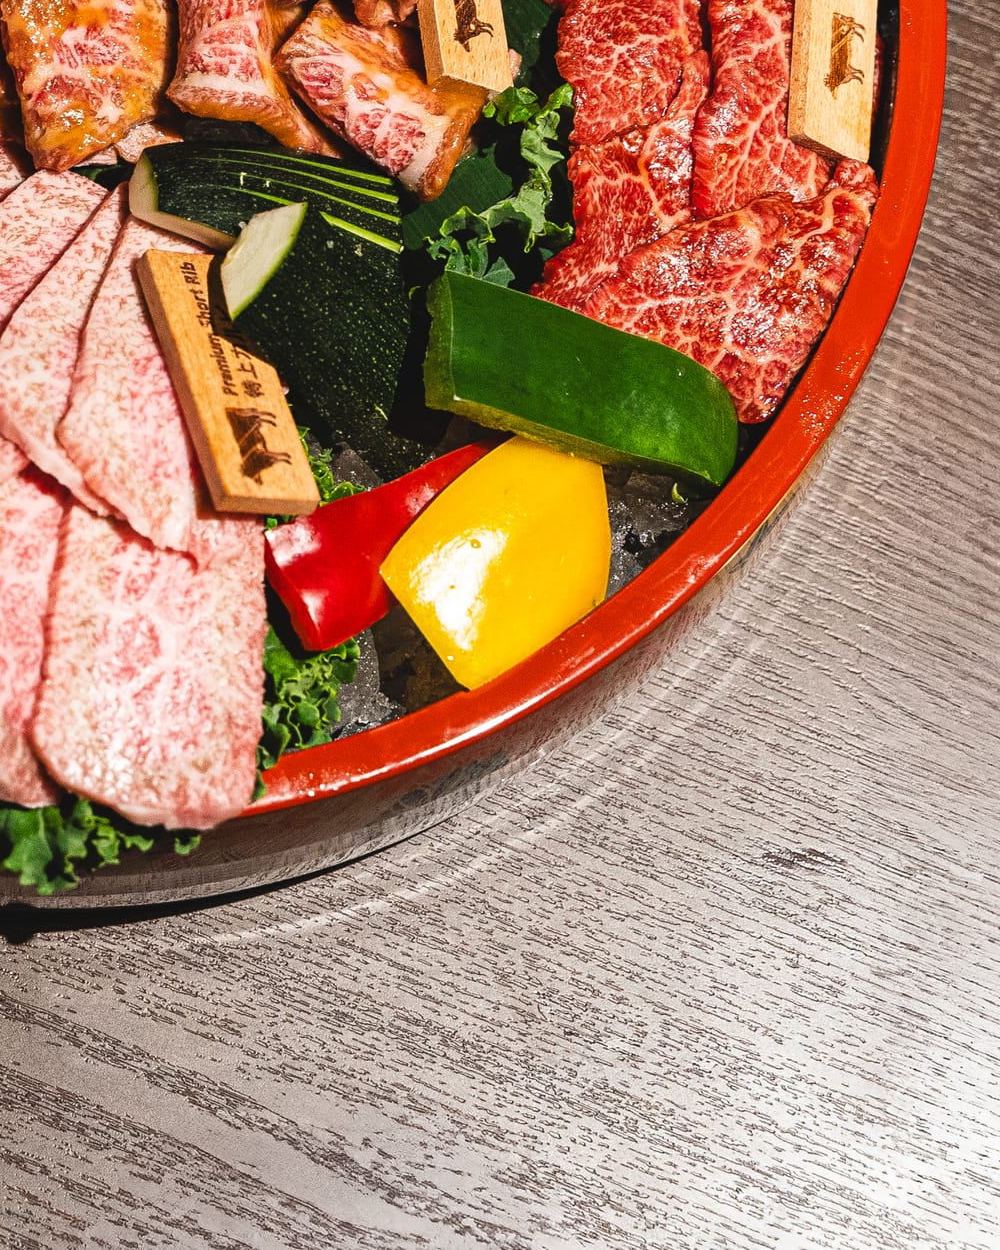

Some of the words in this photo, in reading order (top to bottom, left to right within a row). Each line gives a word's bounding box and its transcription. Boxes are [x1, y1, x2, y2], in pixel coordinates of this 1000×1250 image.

[180, 261, 201, 285] Rib
[190, 288, 211, 328] Short
[208, 332, 239, 397] Premium
